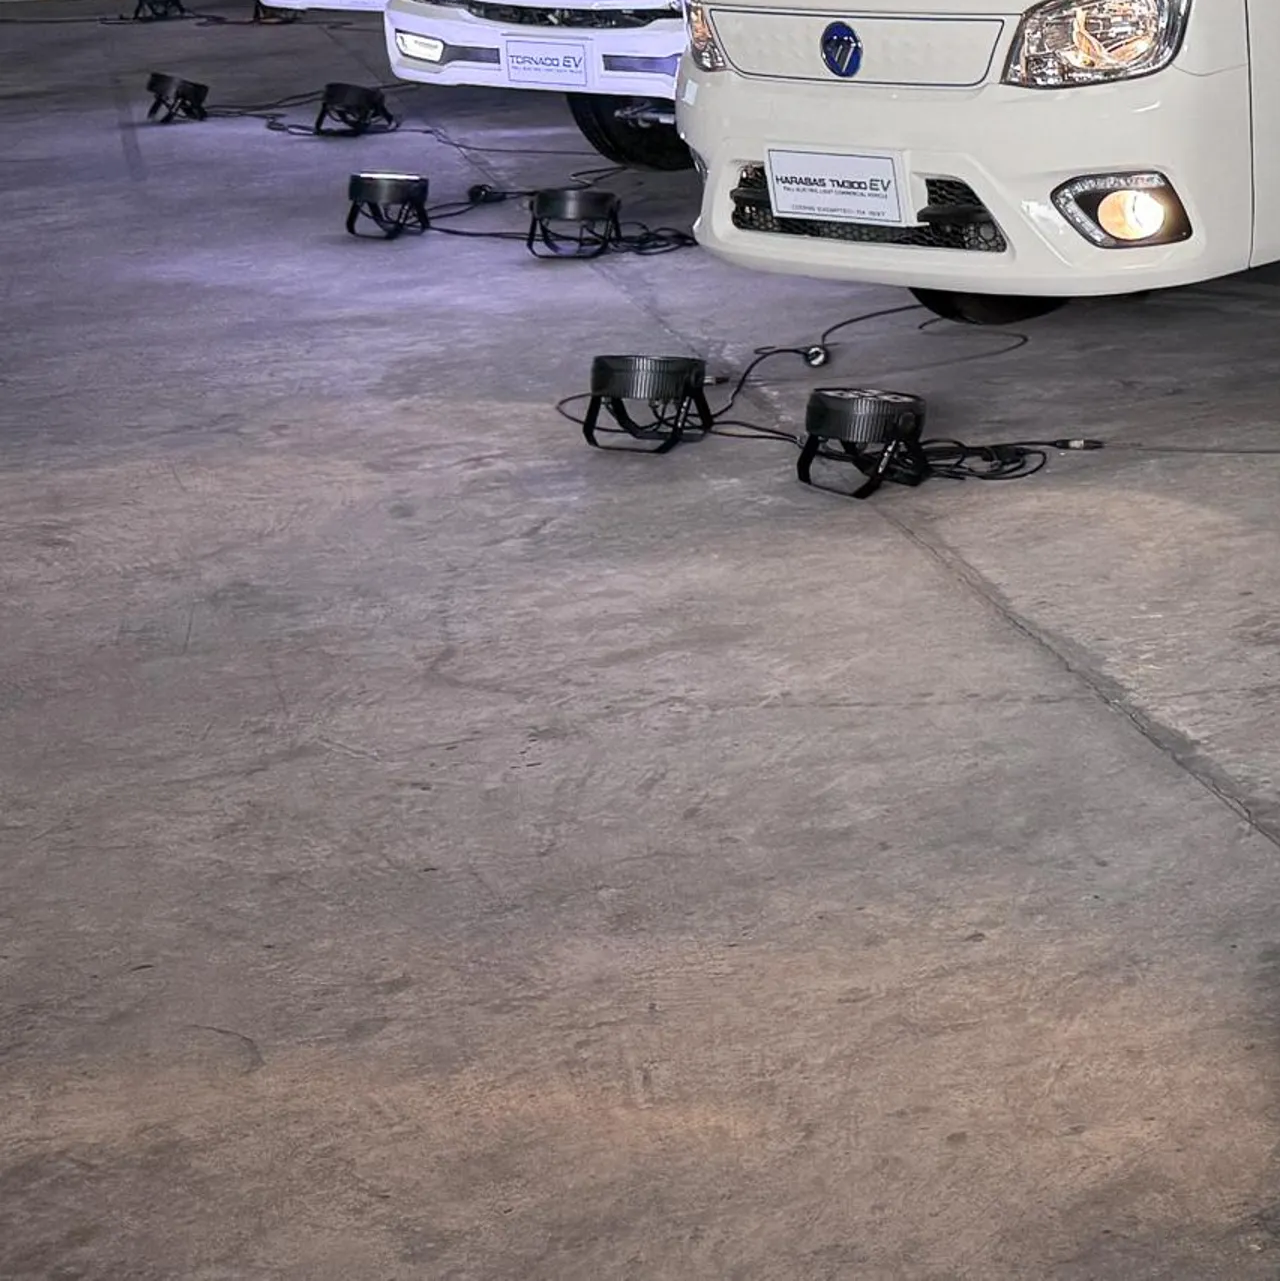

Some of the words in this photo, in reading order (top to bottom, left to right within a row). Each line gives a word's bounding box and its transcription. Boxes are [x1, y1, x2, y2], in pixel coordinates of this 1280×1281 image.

[562, 55, 583, 68] EV
[775, 175, 826, 188] HARABAS
[829, 178, 868, 191] TM300
[869, 178, 891, 192] EV
